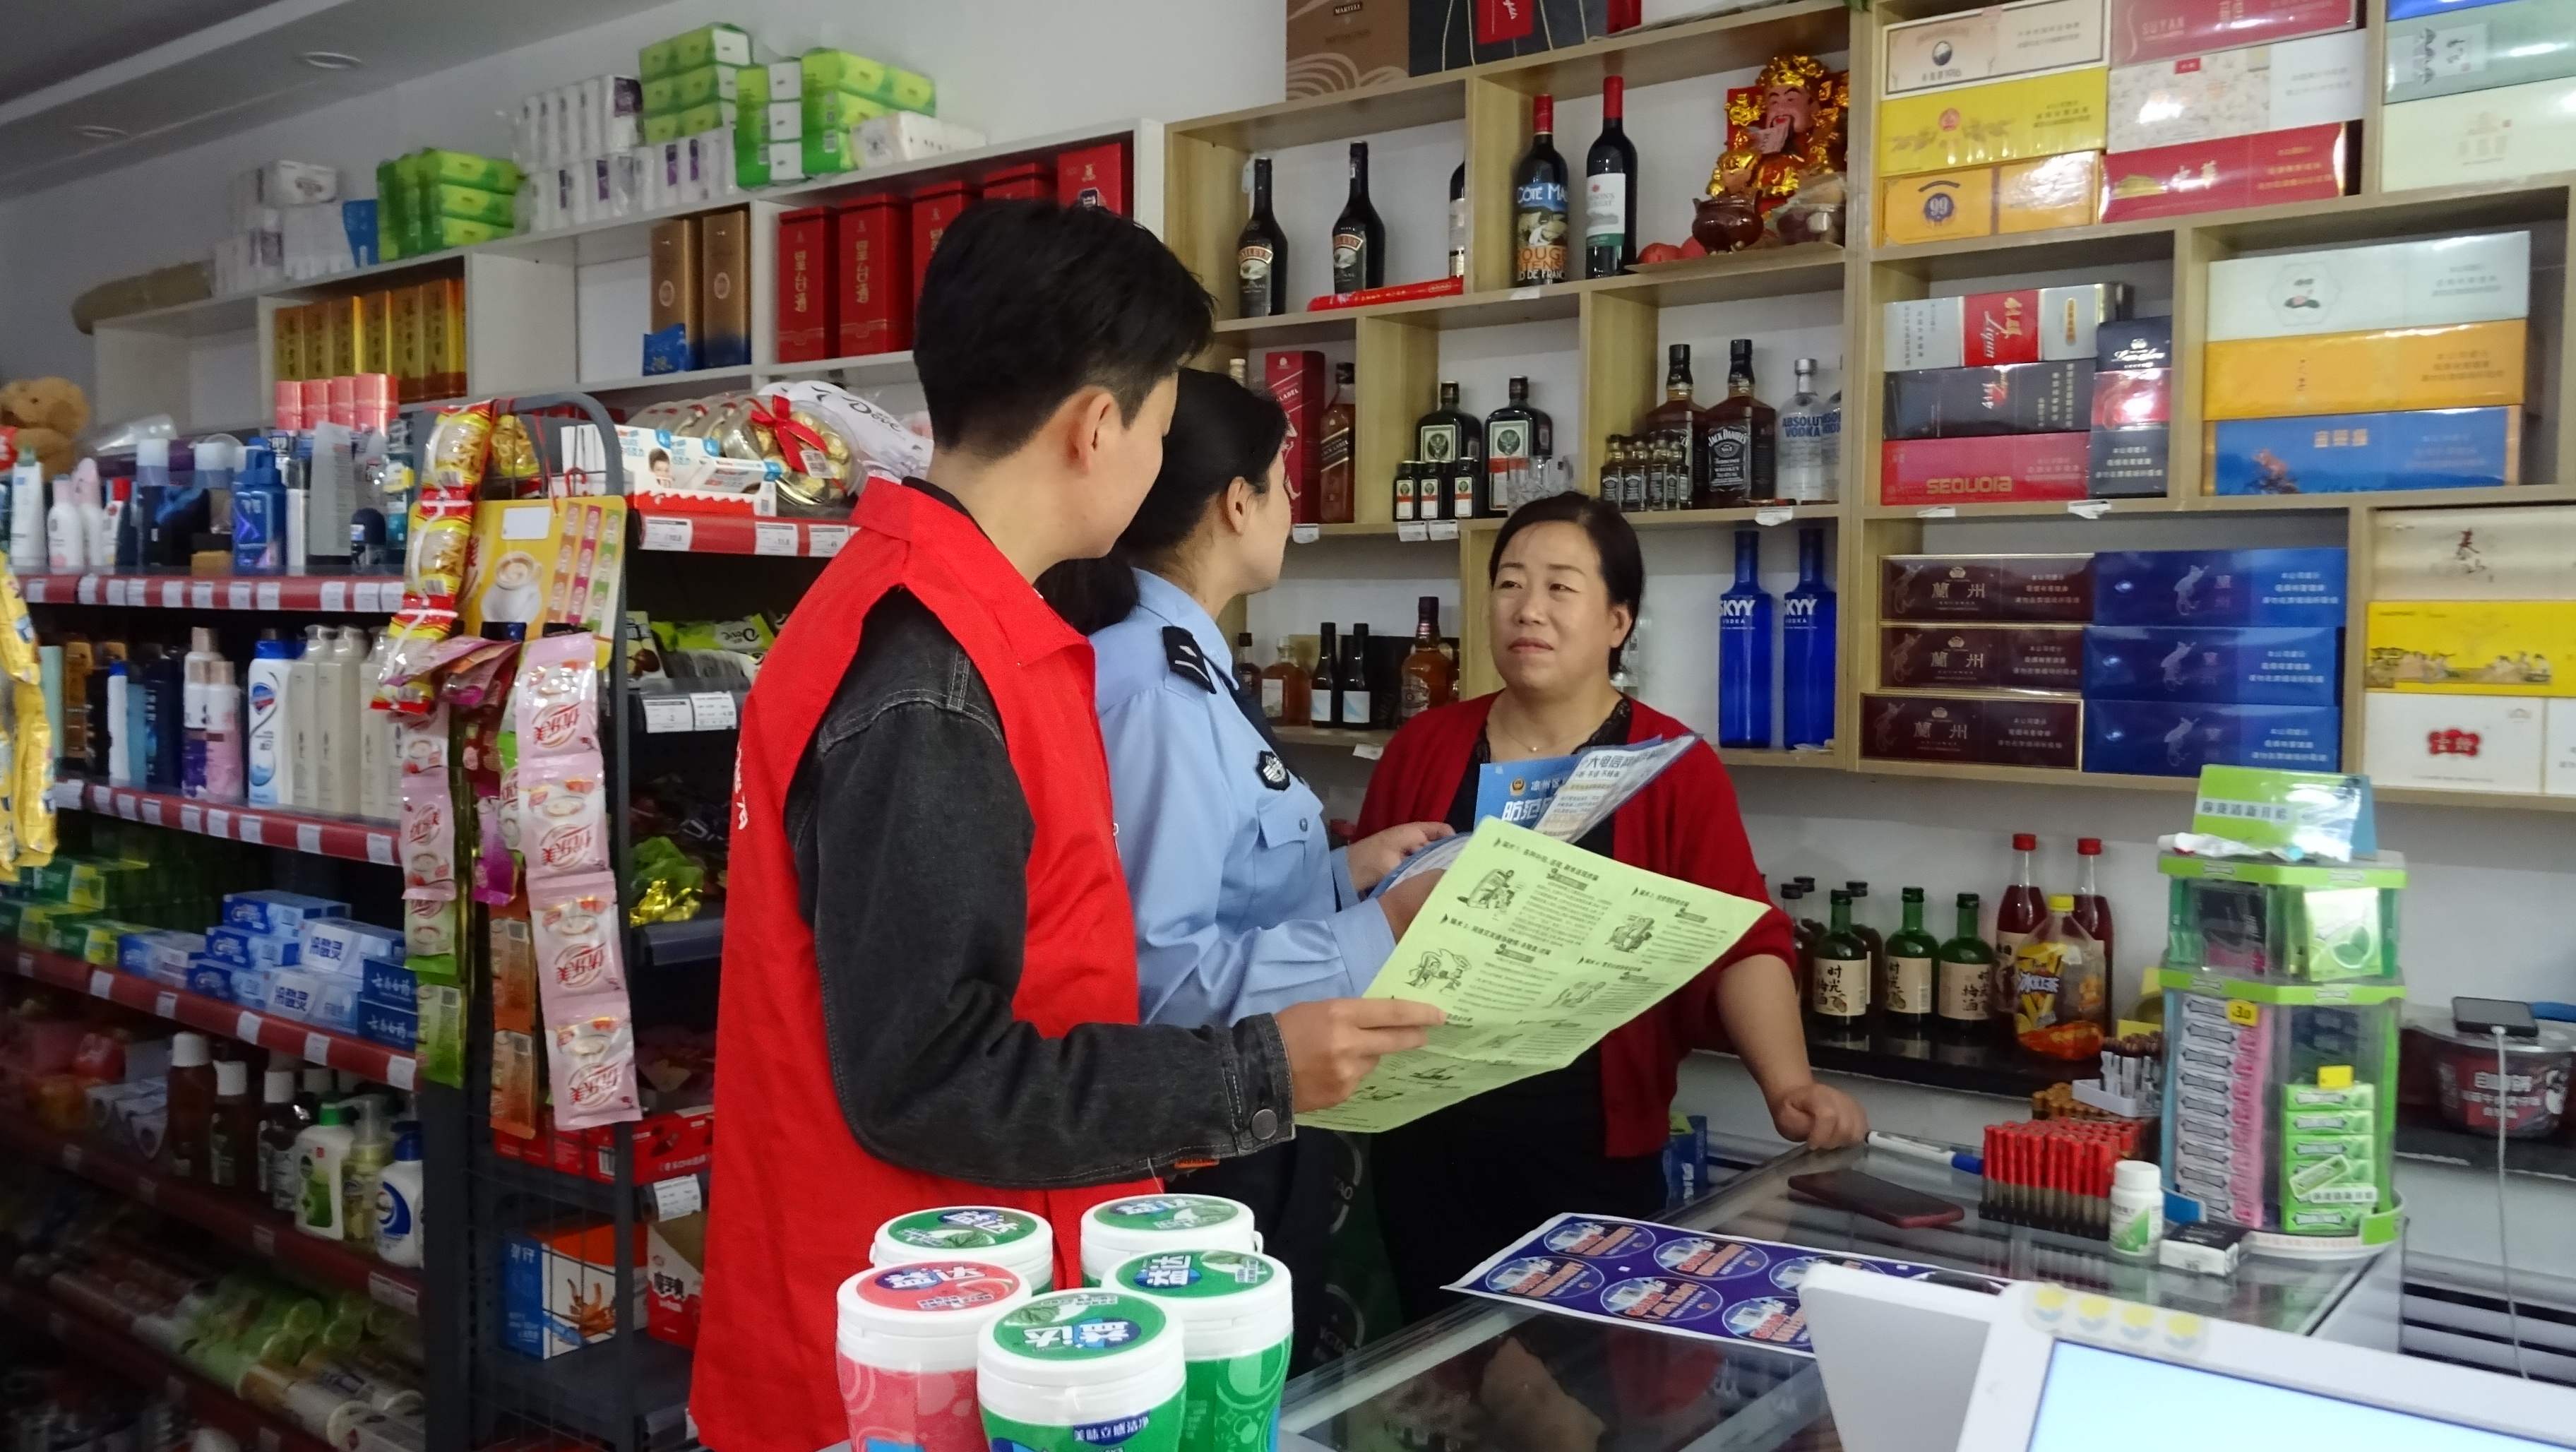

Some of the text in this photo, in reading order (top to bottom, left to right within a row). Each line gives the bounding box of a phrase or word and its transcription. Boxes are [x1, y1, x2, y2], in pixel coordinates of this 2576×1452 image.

[1930, 197, 1948, 215] 99
[1784, 426, 1822, 438] VODKA
[885, 1265, 987, 1289] 益达
[1146, 1254, 1192, 1287] 益达
[1023, 1321, 1130, 1349] 益达
